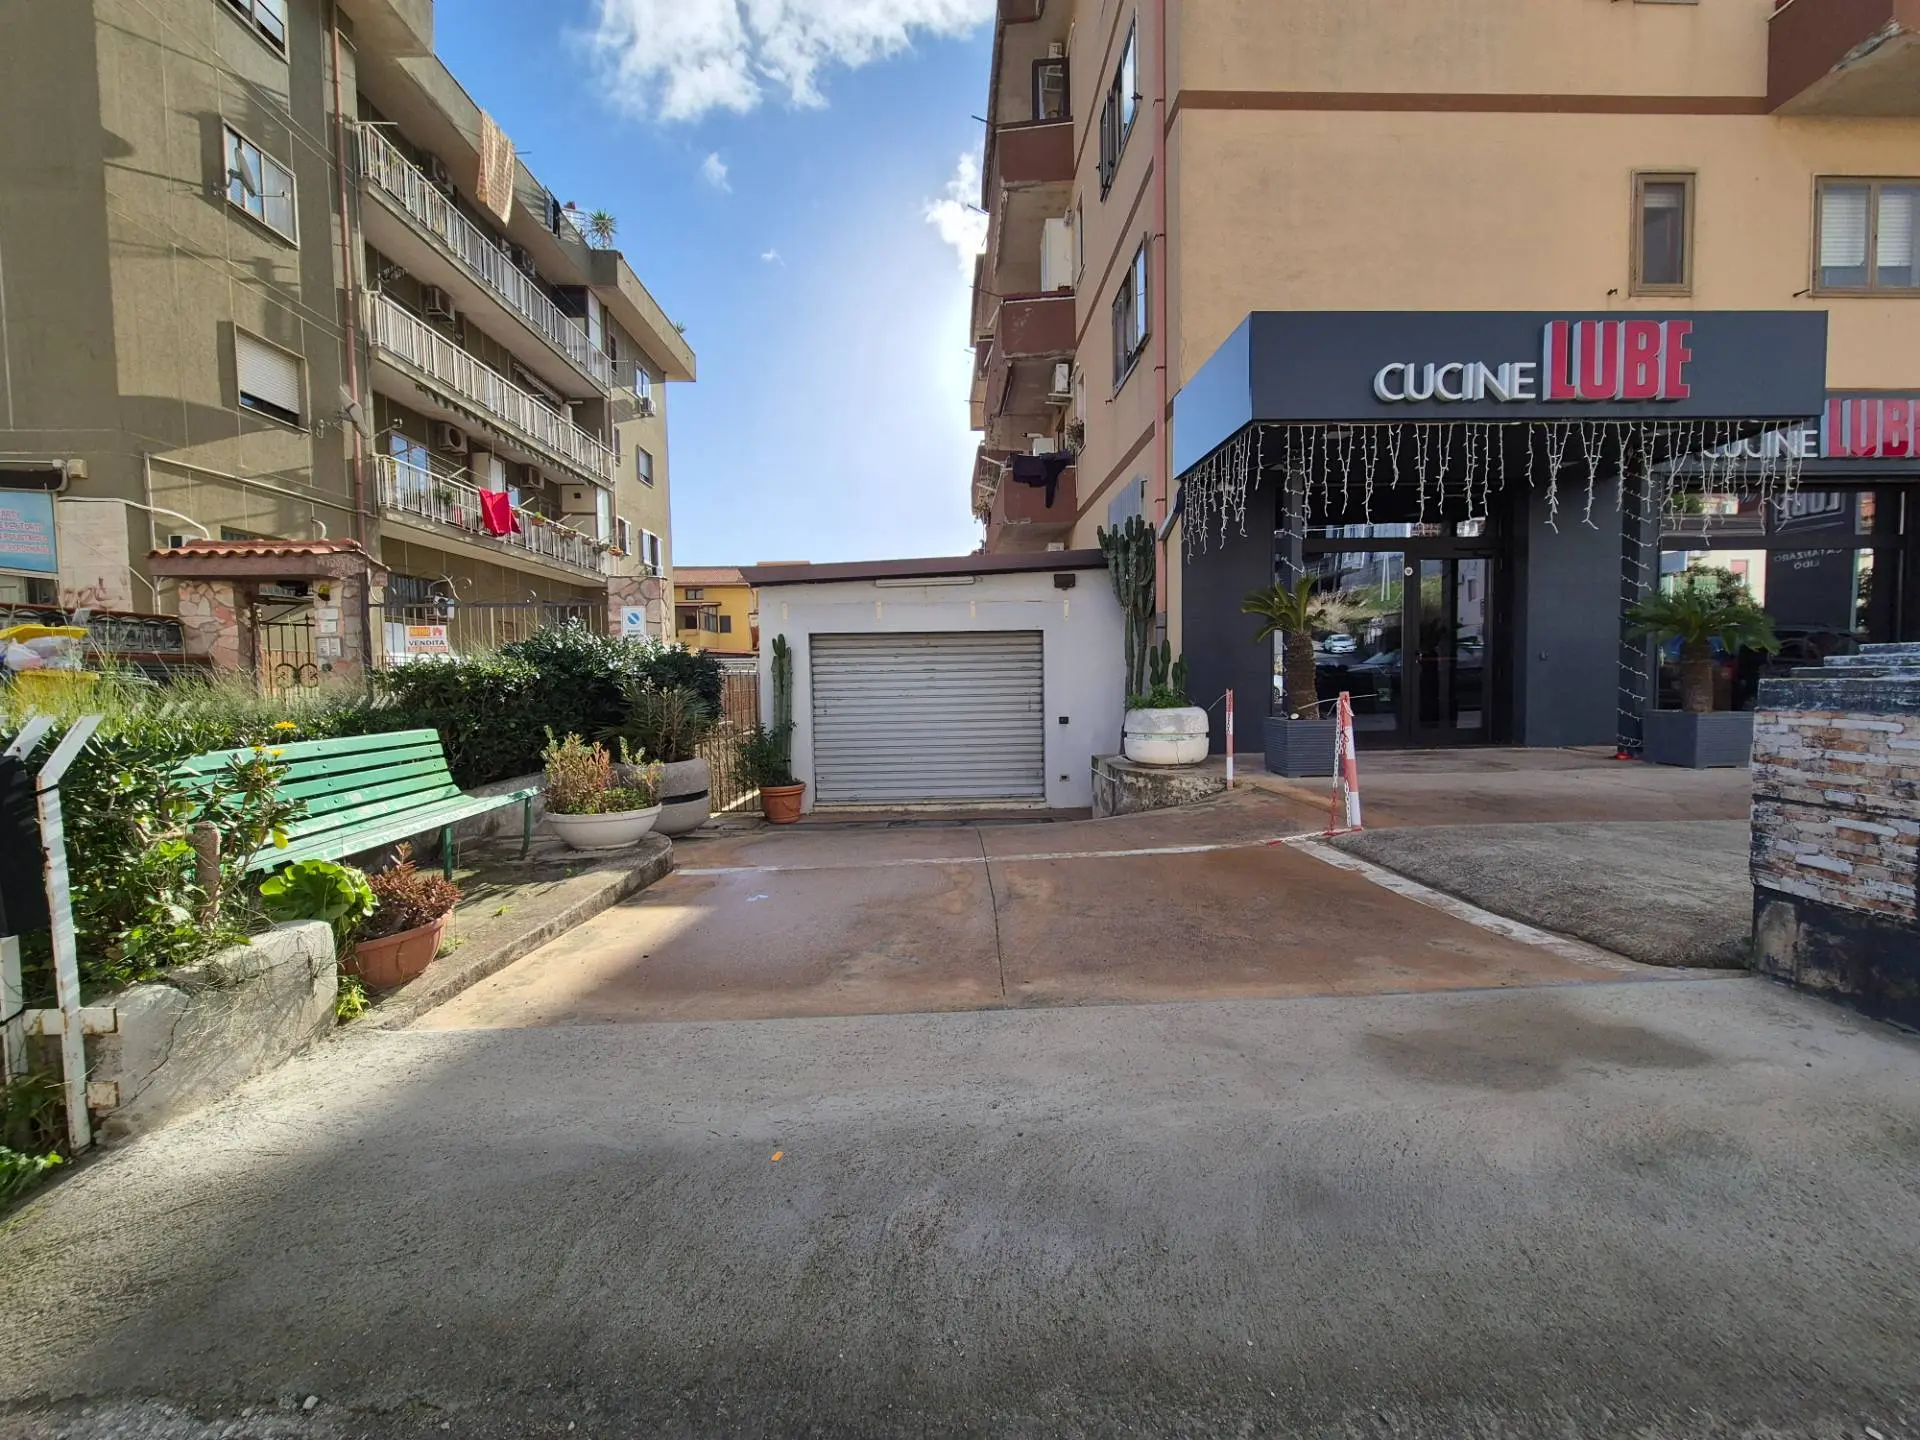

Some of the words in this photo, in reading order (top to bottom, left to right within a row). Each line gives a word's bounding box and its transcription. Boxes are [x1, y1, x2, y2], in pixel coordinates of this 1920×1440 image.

[1373, 361, 1537, 401] CUCINE
[1543, 320, 1692, 401] LUBE
[1820, 399, 1920, 458] LUB
